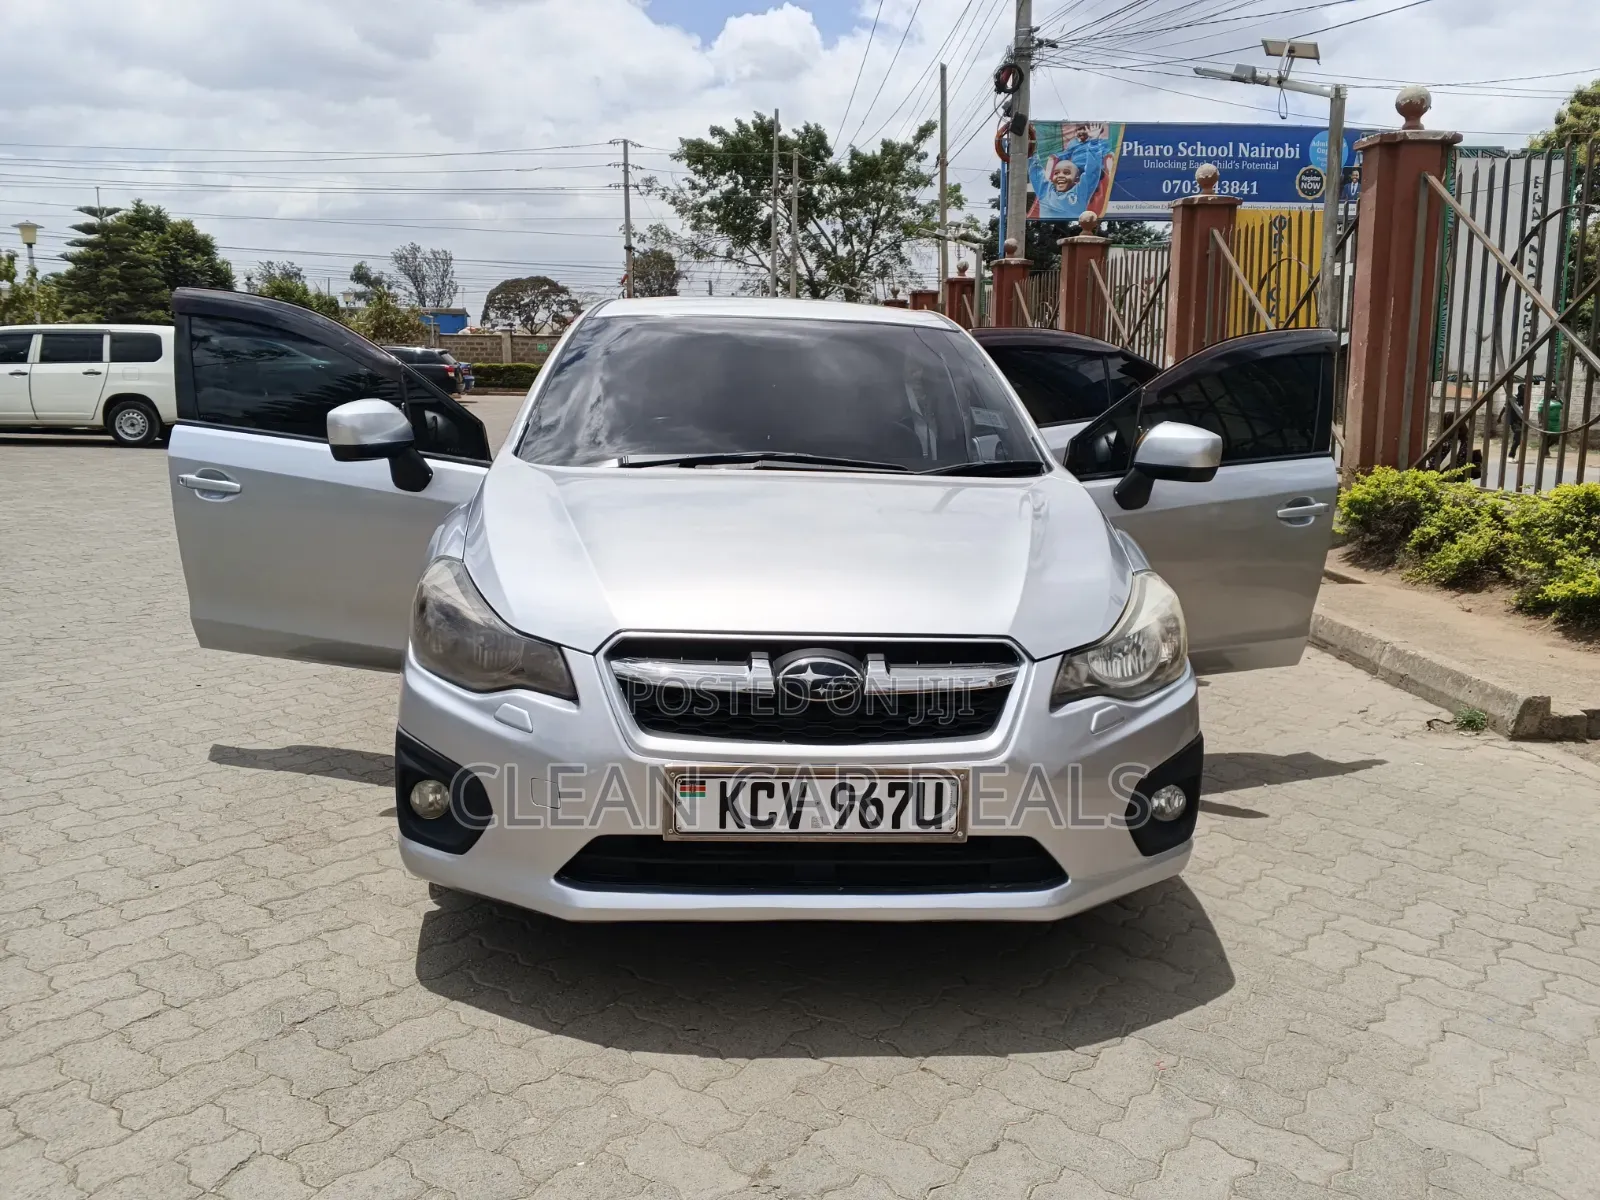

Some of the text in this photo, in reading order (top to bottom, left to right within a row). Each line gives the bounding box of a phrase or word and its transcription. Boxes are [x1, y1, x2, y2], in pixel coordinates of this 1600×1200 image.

[1121, 141, 1173, 157] Pharo
[1177, 141, 1233, 158] School
[1238, 142, 1300, 159] Nairobi
[1143, 159, 1187, 170] Unlocking
[1241, 161, 1279, 170] Potential
[1301, 174, 1321, 182] Register
[1162, 180, 1258, 195] 070343841
[1301, 181, 1321, 190] NOW
[719, 781, 809, 829] KCV
[830, 781, 944, 829] 967U
